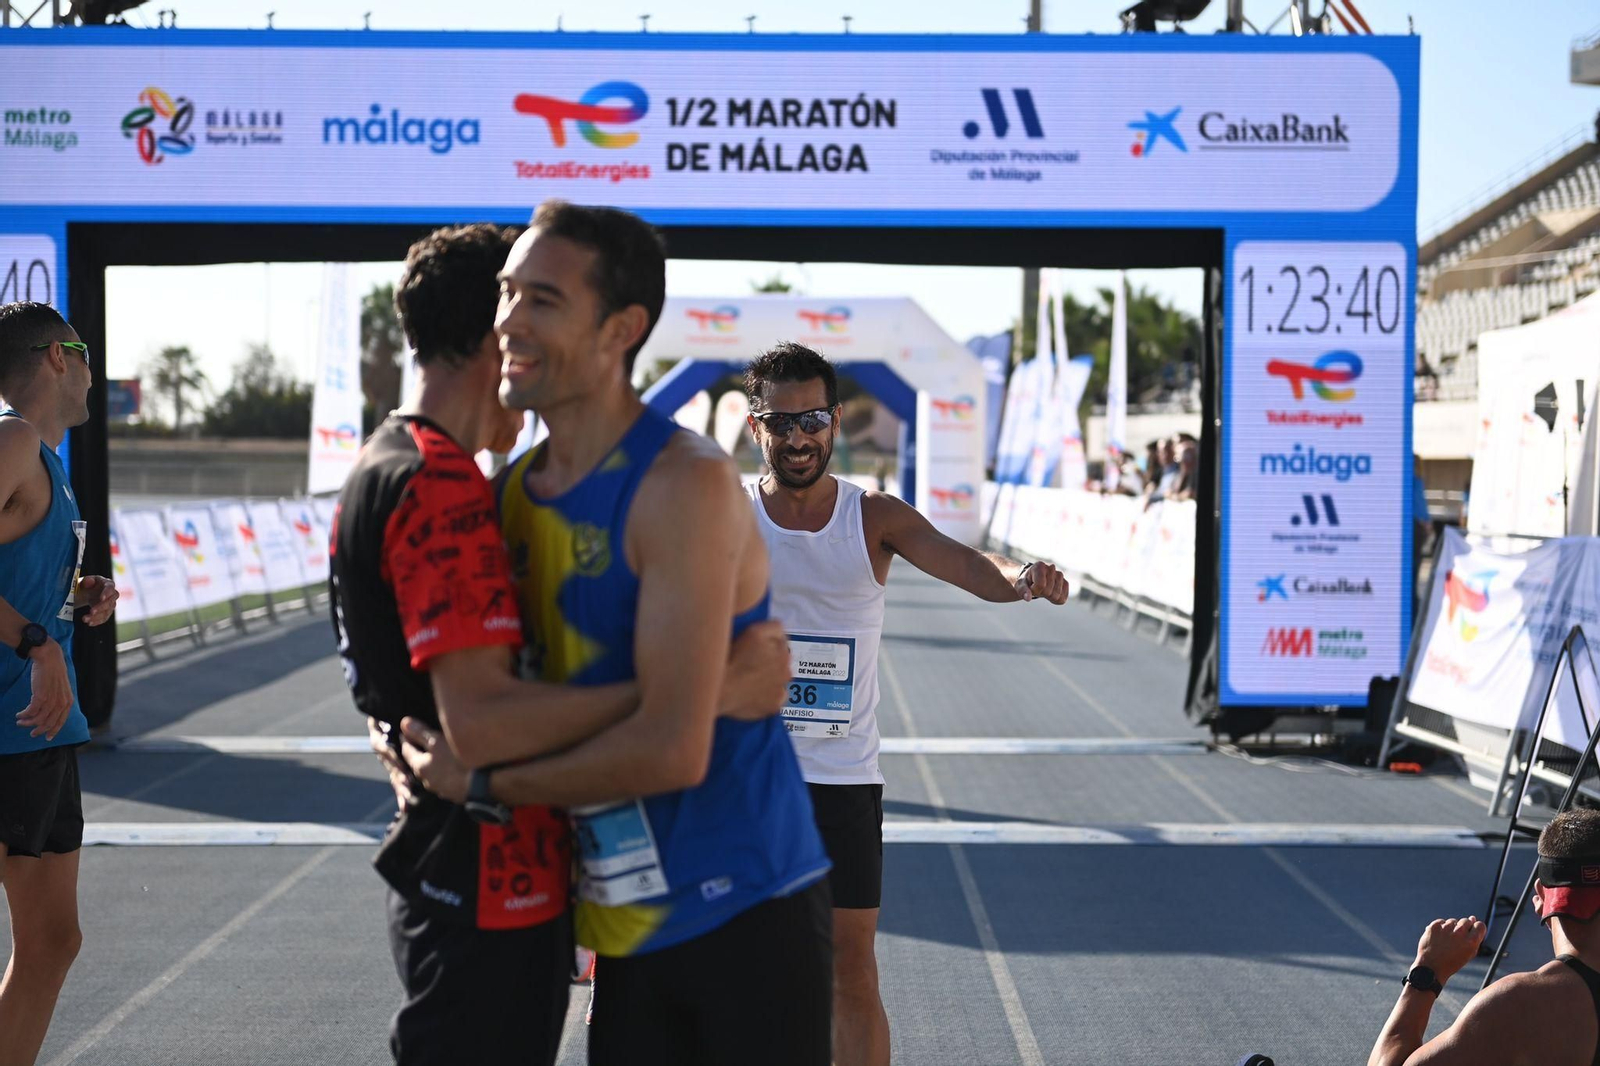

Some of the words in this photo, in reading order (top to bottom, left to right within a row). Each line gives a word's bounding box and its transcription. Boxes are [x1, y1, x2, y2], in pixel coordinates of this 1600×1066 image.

[5, 107, 71, 125] metro
[665, 98, 718, 127] 1/2
[727, 92, 897, 127] MARATÓN
[323, 103, 480, 154] málaga
[1198, 112, 1350, 143] CaixaBank
[4, 128, 78, 151] Málaga
[666, 143, 709, 171] DE
[720, 138, 869, 172] MÁLAGA
[513, 160, 650, 182] TotalEnergies
[1240, 265, 1400, 334] 1:23:40
[1266, 409, 1363, 429] TotalEnergies
[1260, 444, 1372, 482] málaga
[806, 668, 831, 676] MÁLAGA
[808, 661, 837, 669] MARATÓN
[788, 684, 817, 706] 36
